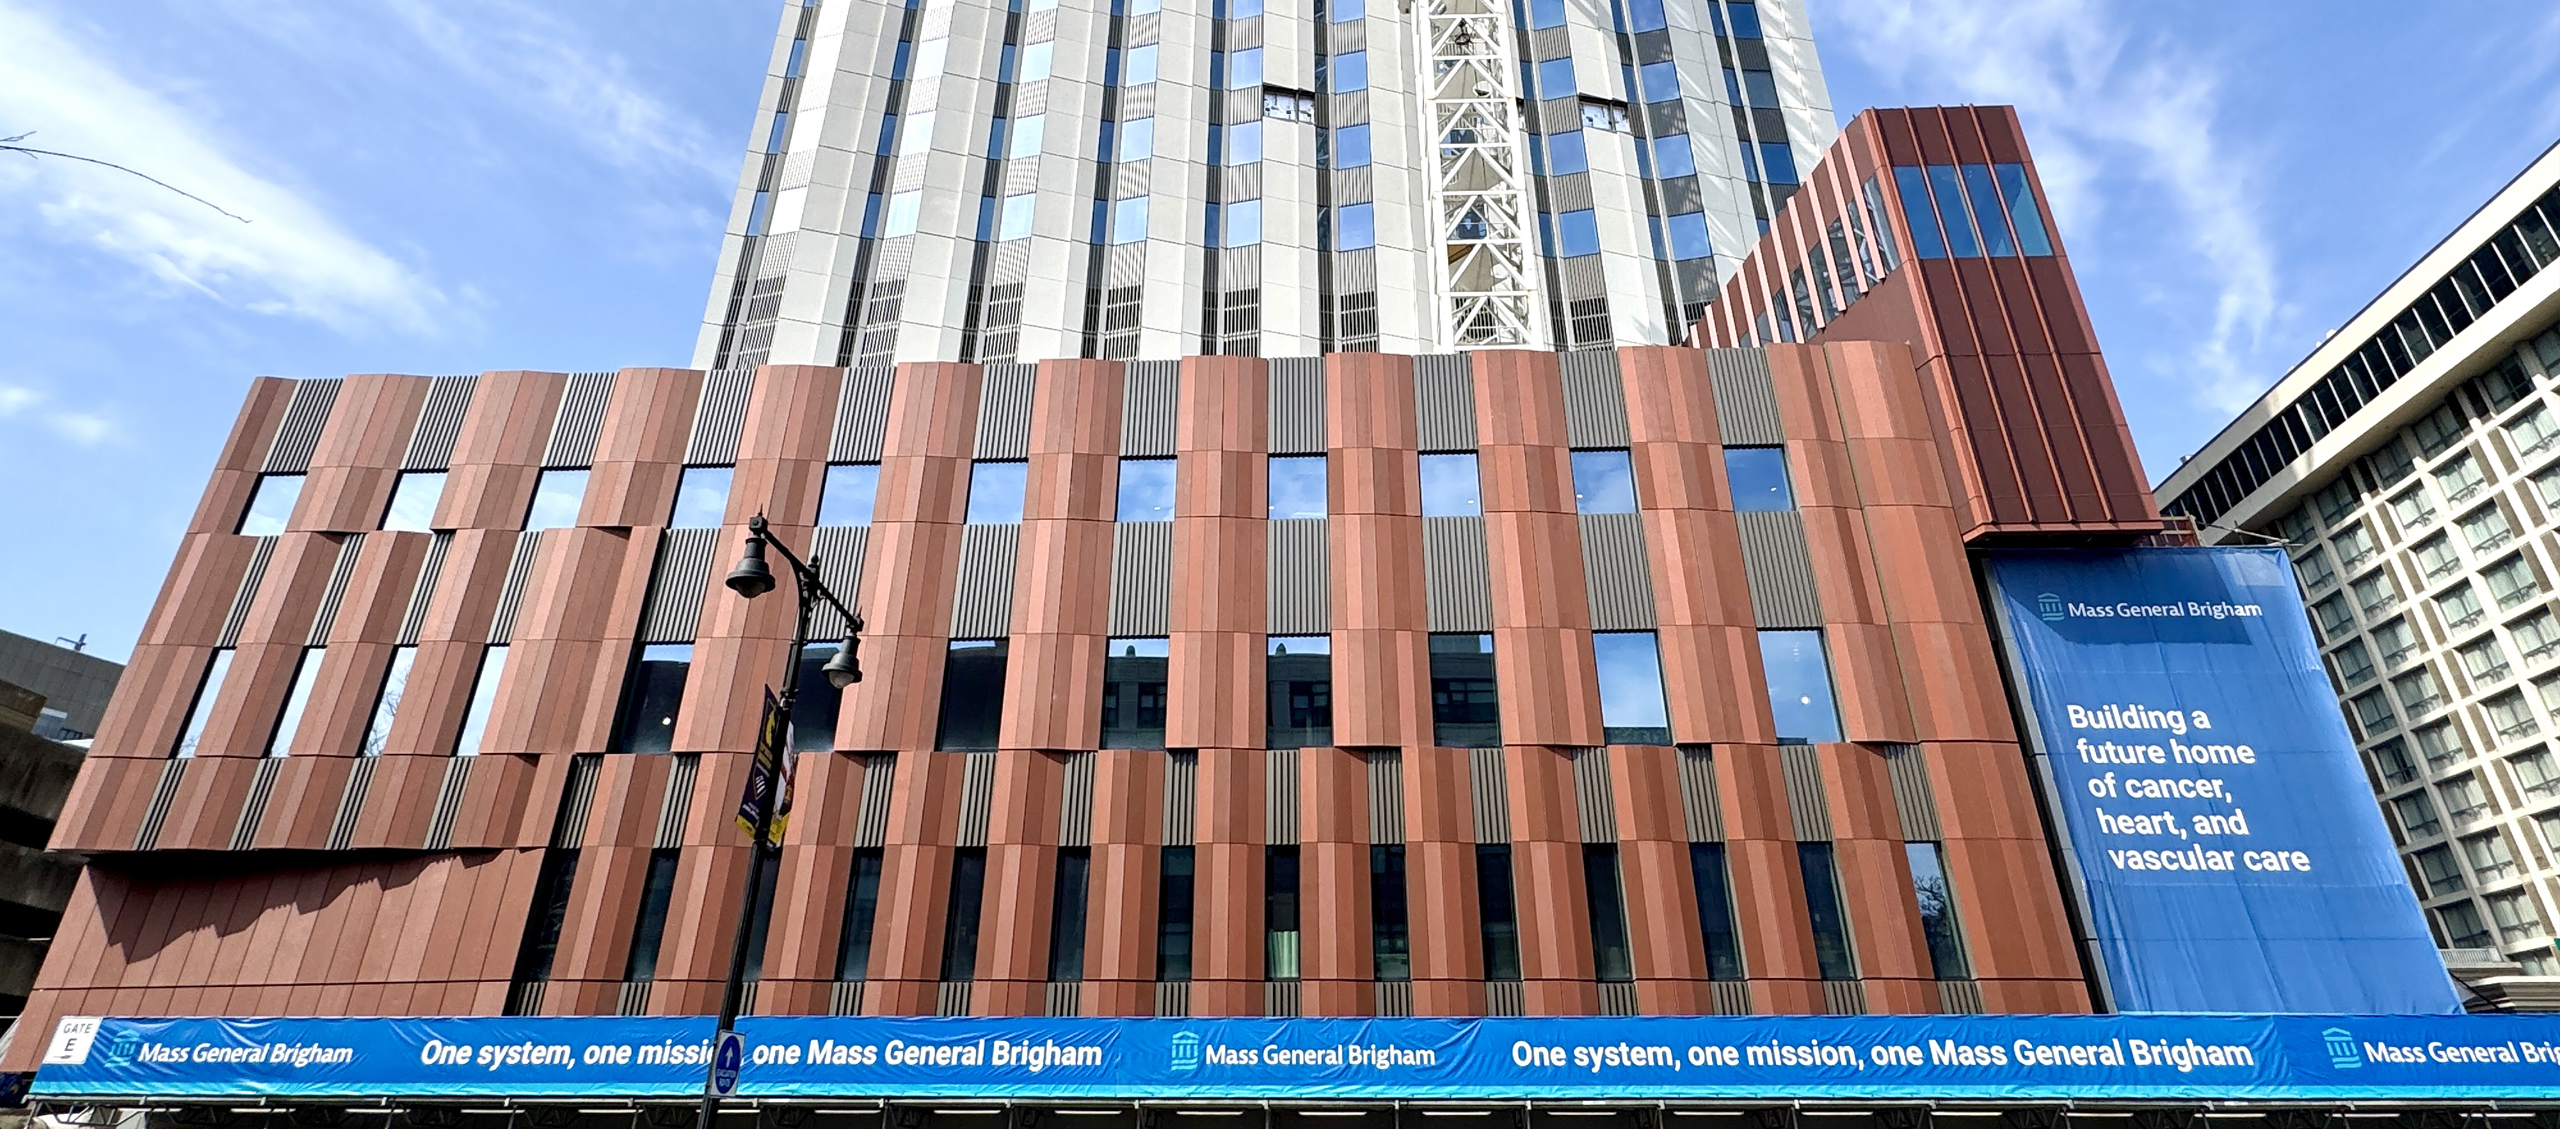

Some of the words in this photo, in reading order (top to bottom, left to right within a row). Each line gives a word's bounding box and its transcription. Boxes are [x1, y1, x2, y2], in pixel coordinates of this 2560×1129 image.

[2068, 603, 2114, 617] Mass
[2116, 602, 2184, 617] General
[2187, 601, 2263, 620] Brigham
[2066, 704, 2187, 735] Building
[2191, 710, 2212, 729] a
[2076, 737, 2167, 764] future
[2169, 738, 2256, 764] home
[2088, 771, 2117, 798] of
[2125, 779, 2232, 804] cancer,
[2095, 807, 2187, 840] heart,
[2192, 808, 2250, 835] and
[2108, 843, 2235, 871] vascular
[2243, 850, 2311, 872] care
[63, 1023, 93, 1034] GATE
[64, 1038, 78, 1052] E
[137, 1042, 191, 1062] Mass
[192, 1042, 270, 1063] General
[269, 1042, 353, 1068] Brigham
[421, 1039, 472, 1065] One
[476, 1041, 576, 1071] system,
[583, 1045, 632, 1065] one
[636, 1038, 745, 1067] missi,
[752, 1044, 801, 1065] one
[807, 1039, 878, 1065] Mass
[884, 1038, 985, 1066] General
[992, 1039, 1102, 1072] Brigham
[1206, 1044, 1259, 1065] Mass
[1263, 1044, 1343, 1065] General
[1348, 1044, 1436, 1070] Brigham
[1512, 1040, 1567, 1067] One
[1573, 1042, 1681, 1073] system,
[1688, 1046, 1740, 1066] one
[1746, 1039, 1865, 1071] mission,
[1871, 1045, 1924, 1066] one
[1928, 1039, 2008, 1066] Mass
[2013, 1038, 2125, 1066] General
[2128, 1038, 2254, 1073] Brigham
[2363, 1041, 2427, 1063] Mass
[2428, 1040, 2520, 1063] General
